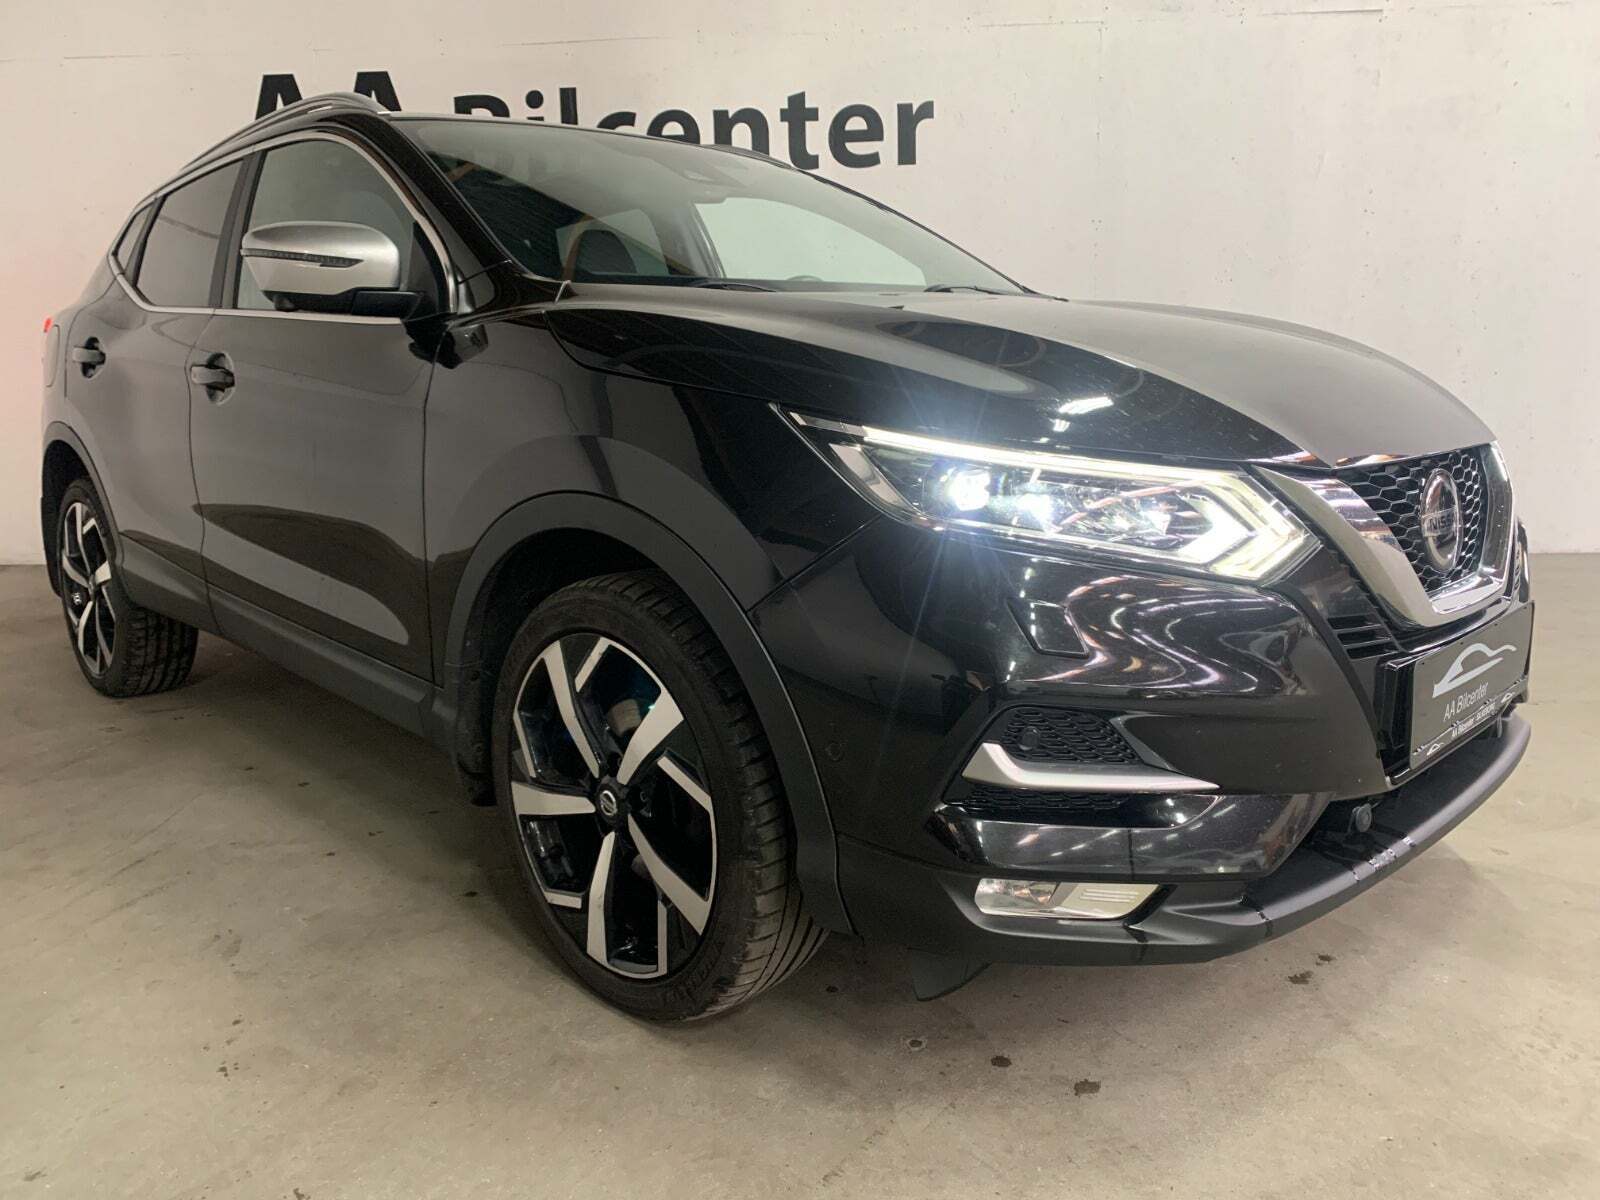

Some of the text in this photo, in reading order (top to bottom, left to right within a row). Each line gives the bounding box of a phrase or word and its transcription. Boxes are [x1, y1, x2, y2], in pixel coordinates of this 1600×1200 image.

[453, 87, 934, 170] enter
[1443, 700, 1456, 722] AA
[1456, 681, 1489, 714] Bilcenter
